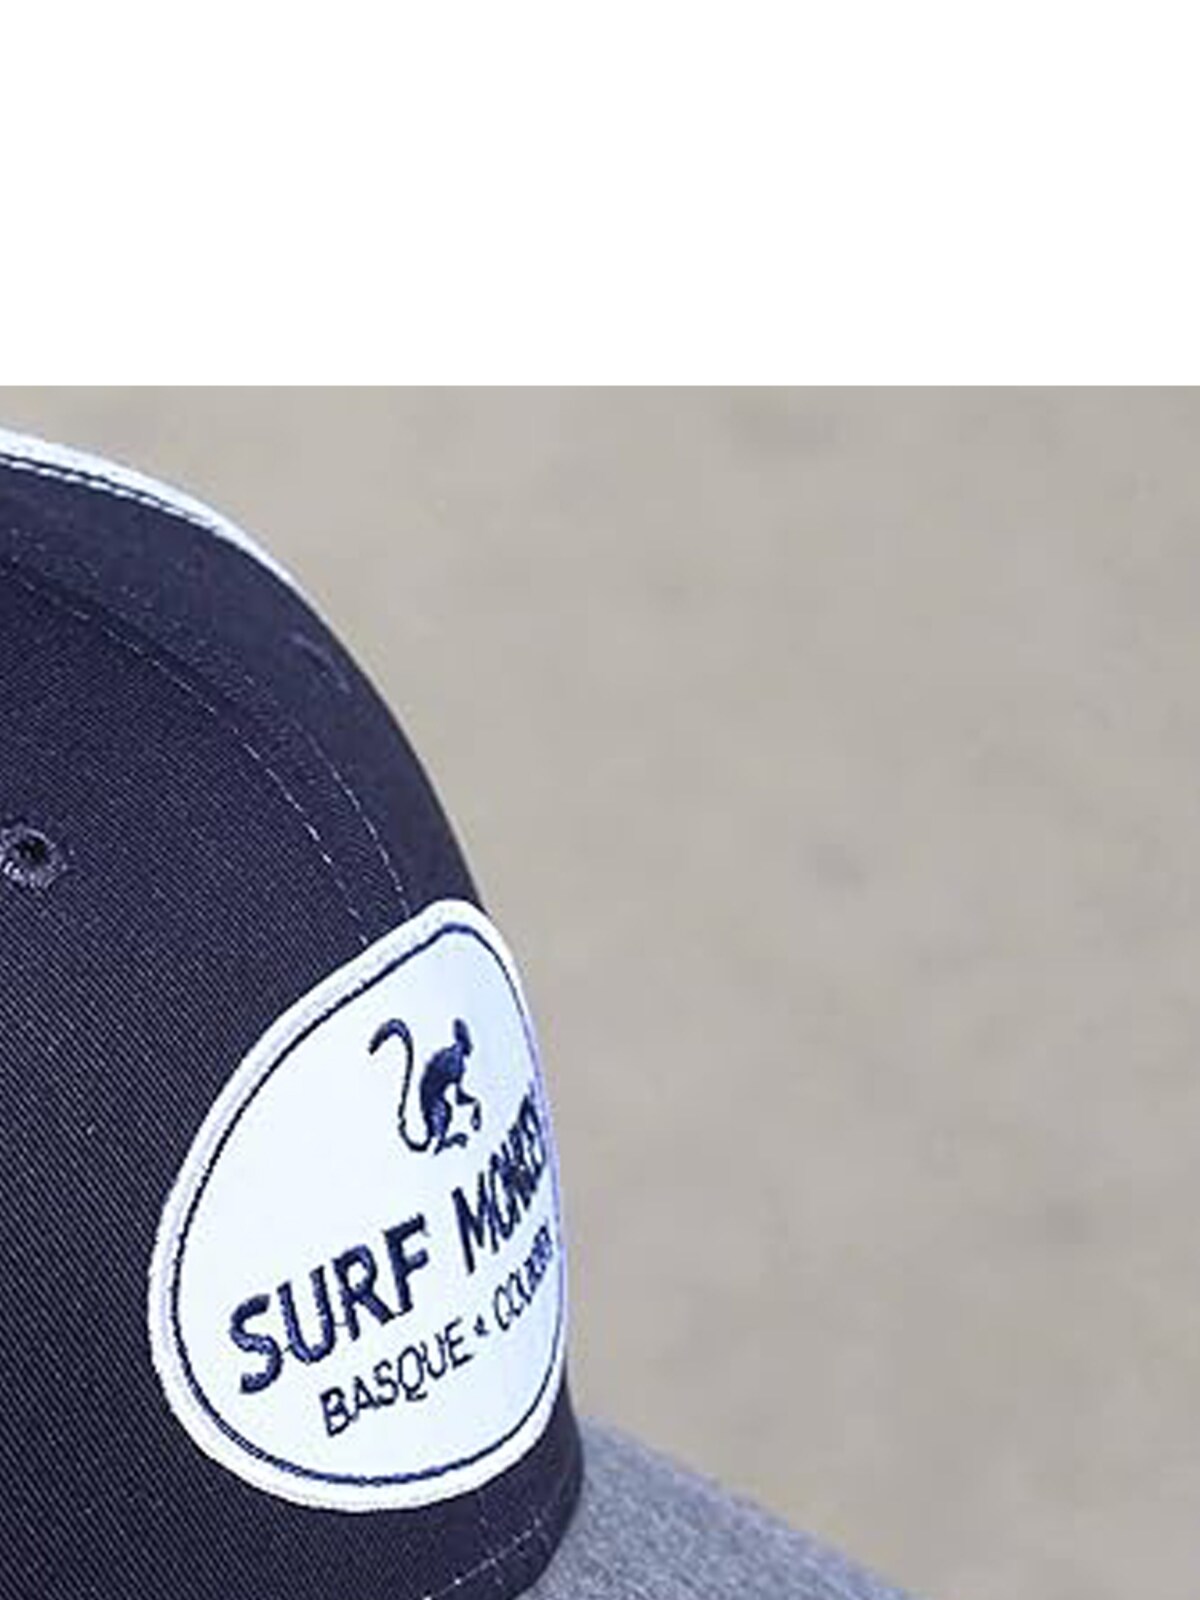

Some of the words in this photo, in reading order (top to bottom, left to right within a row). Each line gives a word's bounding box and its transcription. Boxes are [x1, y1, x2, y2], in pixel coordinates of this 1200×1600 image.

[229, 1213, 430, 1395] SURF
[452, 1085, 547, 1275] MONKE
[320, 1317, 474, 1437] BASQUE
